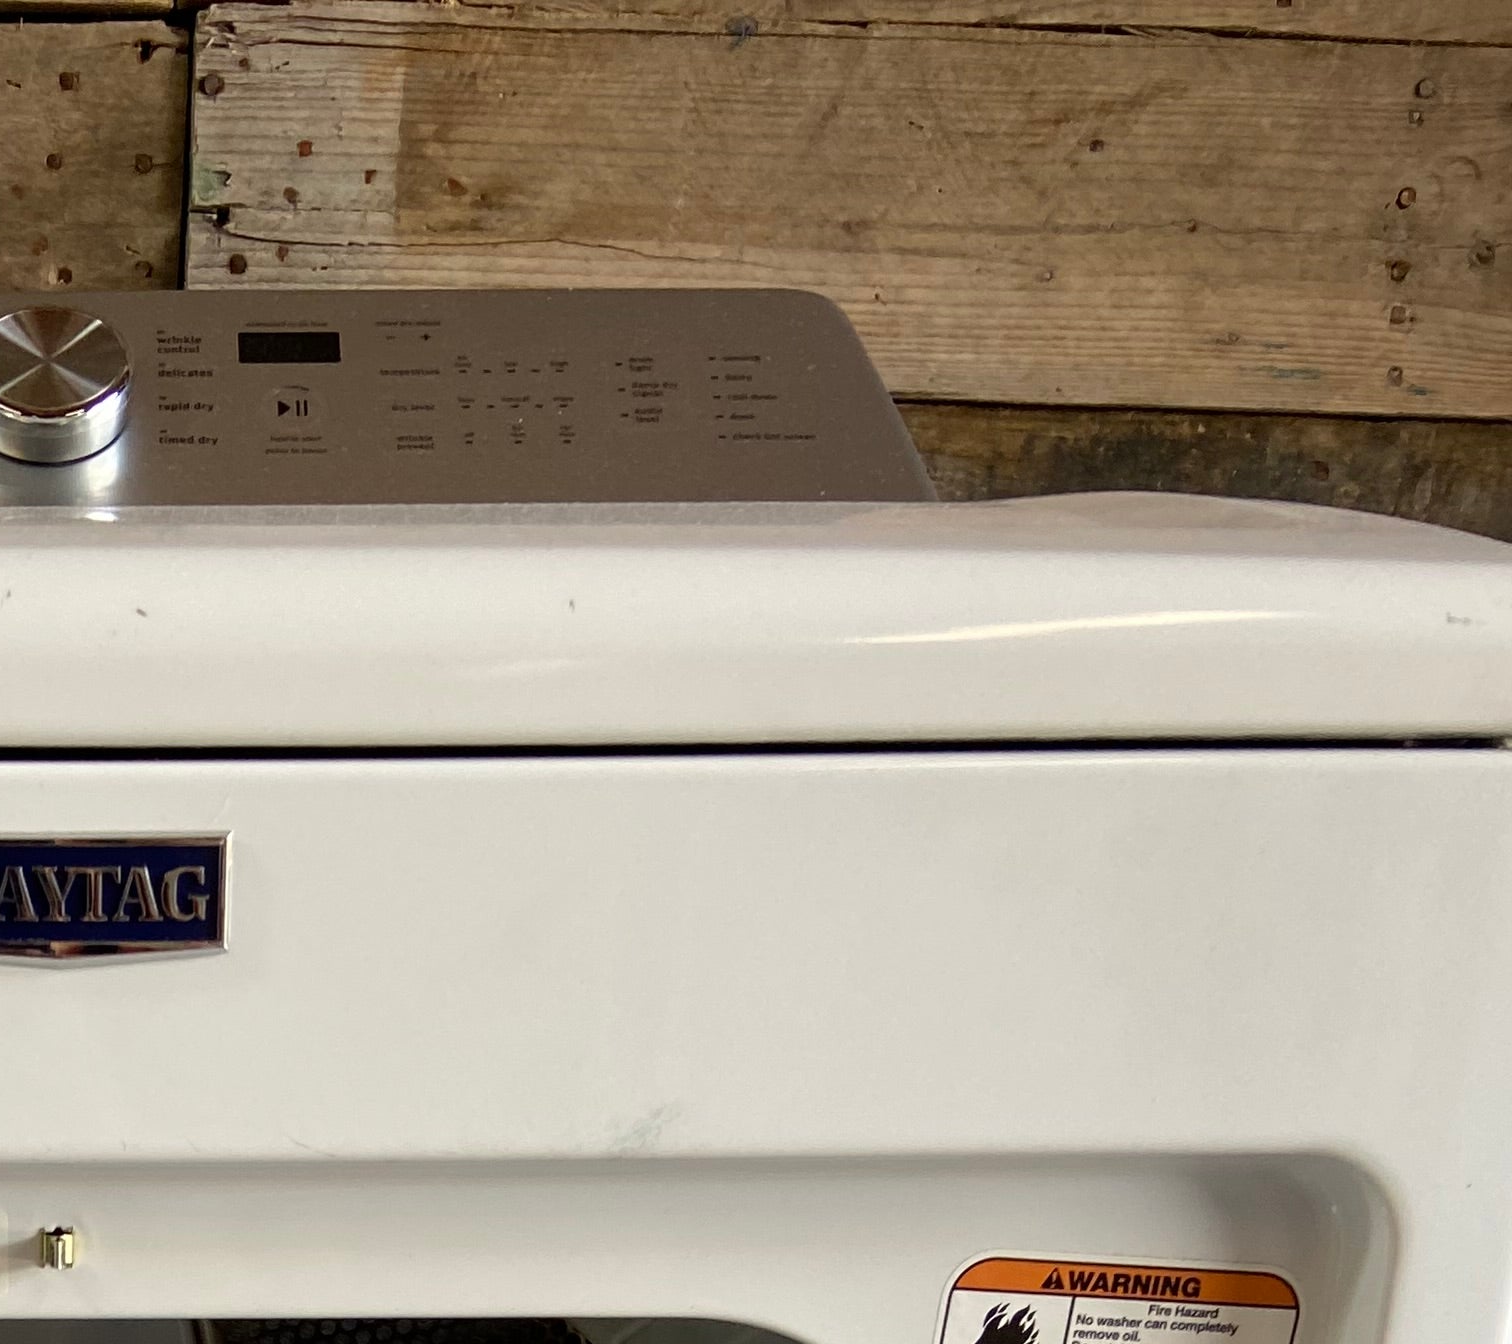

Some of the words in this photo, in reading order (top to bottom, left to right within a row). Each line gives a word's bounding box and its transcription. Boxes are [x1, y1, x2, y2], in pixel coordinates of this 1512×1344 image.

[158, 368, 213, 378] delicates
[158, 402, 190, 412] rapid
[193, 402, 214, 413] dry
[159, 435, 195, 445] timed
[198, 436, 219, 446] dry
[1068, 1270, 1201, 1299] WARNING
[1147, 1304, 1172, 1317] Fire
[1174, 1305, 1220, 1319] Hazard
[1075, 1313, 1094, 1326] No
[1096, 1316, 1143, 1328] washer
[1144, 1320, 1168, 1330] can
[1170, 1321, 1239, 1336] completely
[1072, 1329, 1120, 1341] remove
[1122, 1331, 1141, 1342] oil.
